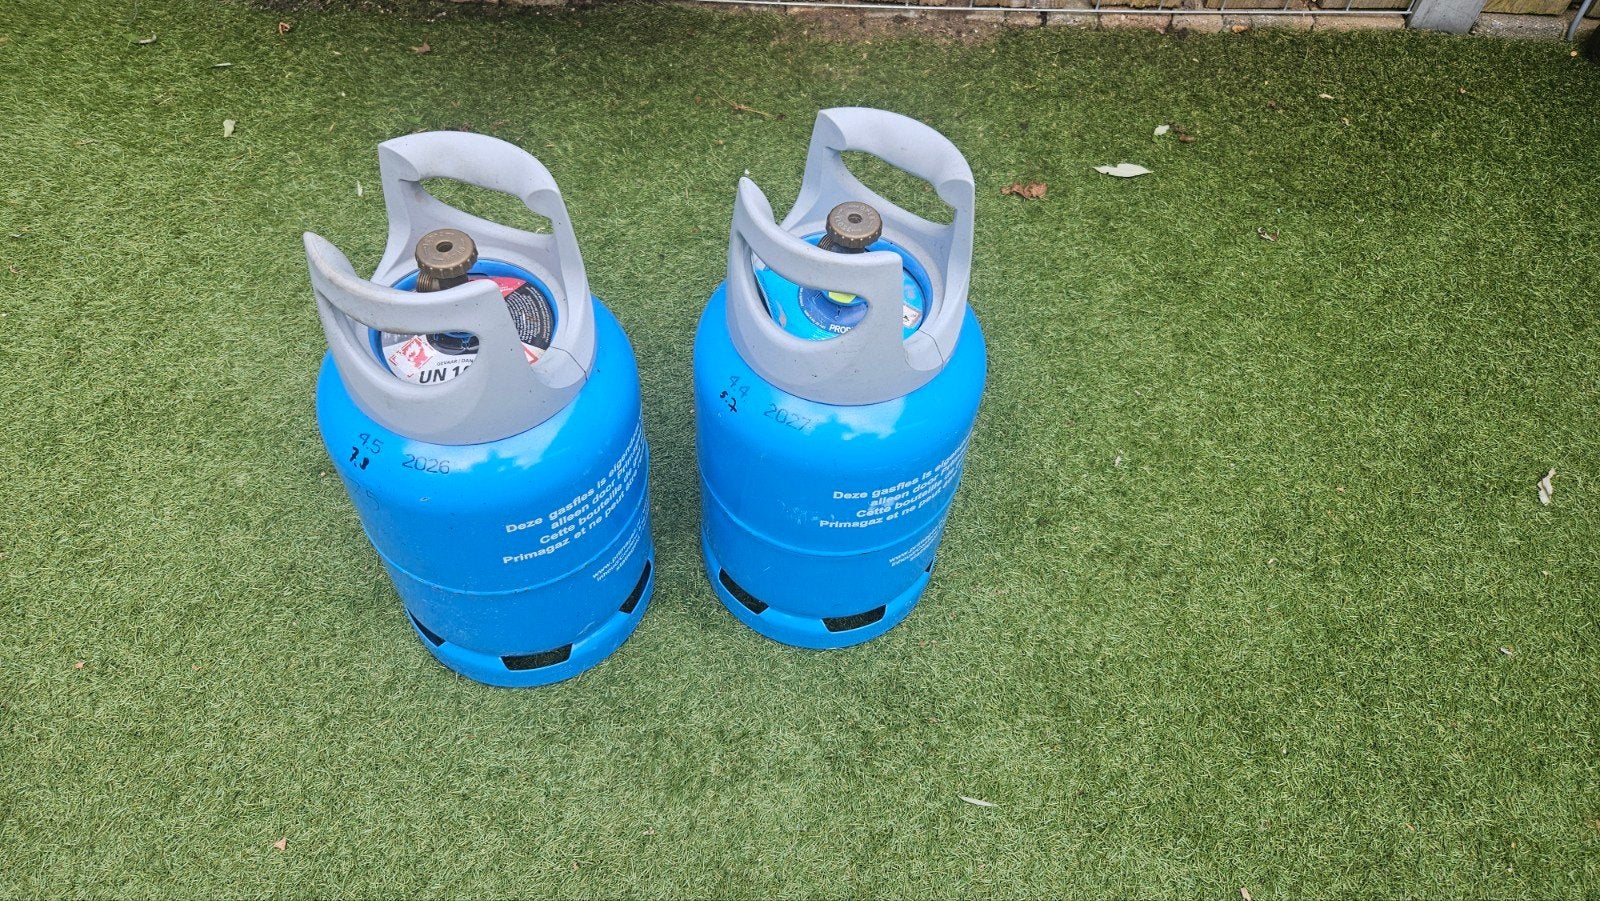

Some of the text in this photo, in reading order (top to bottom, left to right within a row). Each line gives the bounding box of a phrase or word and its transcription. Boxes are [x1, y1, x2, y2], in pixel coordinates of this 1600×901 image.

[419, 365, 470, 384] UN 1
[763, 402, 812, 431] 2027
[401, 453, 450, 475] 2026
[832, 490, 868, 500] Deze
[871, 477, 919, 499] gasfles
[922, 470, 933, 481] is
[856, 505, 892, 518] Cette
[894, 480, 943, 510] bouteille
[870, 474, 940, 507] alleen door
[505, 517, 543, 533] Deze
[549, 487, 595, 521] gasfles
[597, 477, 607, 489] is
[539, 524, 576, 544] Cette
[578, 483, 623, 526] bouteille
[551, 504, 590, 530] alleen
[592, 479, 616, 505] door
[819, 516, 884, 529] Primagaz
[886, 511, 899, 521] et
[901, 505, 917, 516] ne
[502, 537, 571, 564] Primagaz
[574, 527, 587, 540] et
[588, 515, 603, 530] ne
[605, 491, 625, 518] peut
